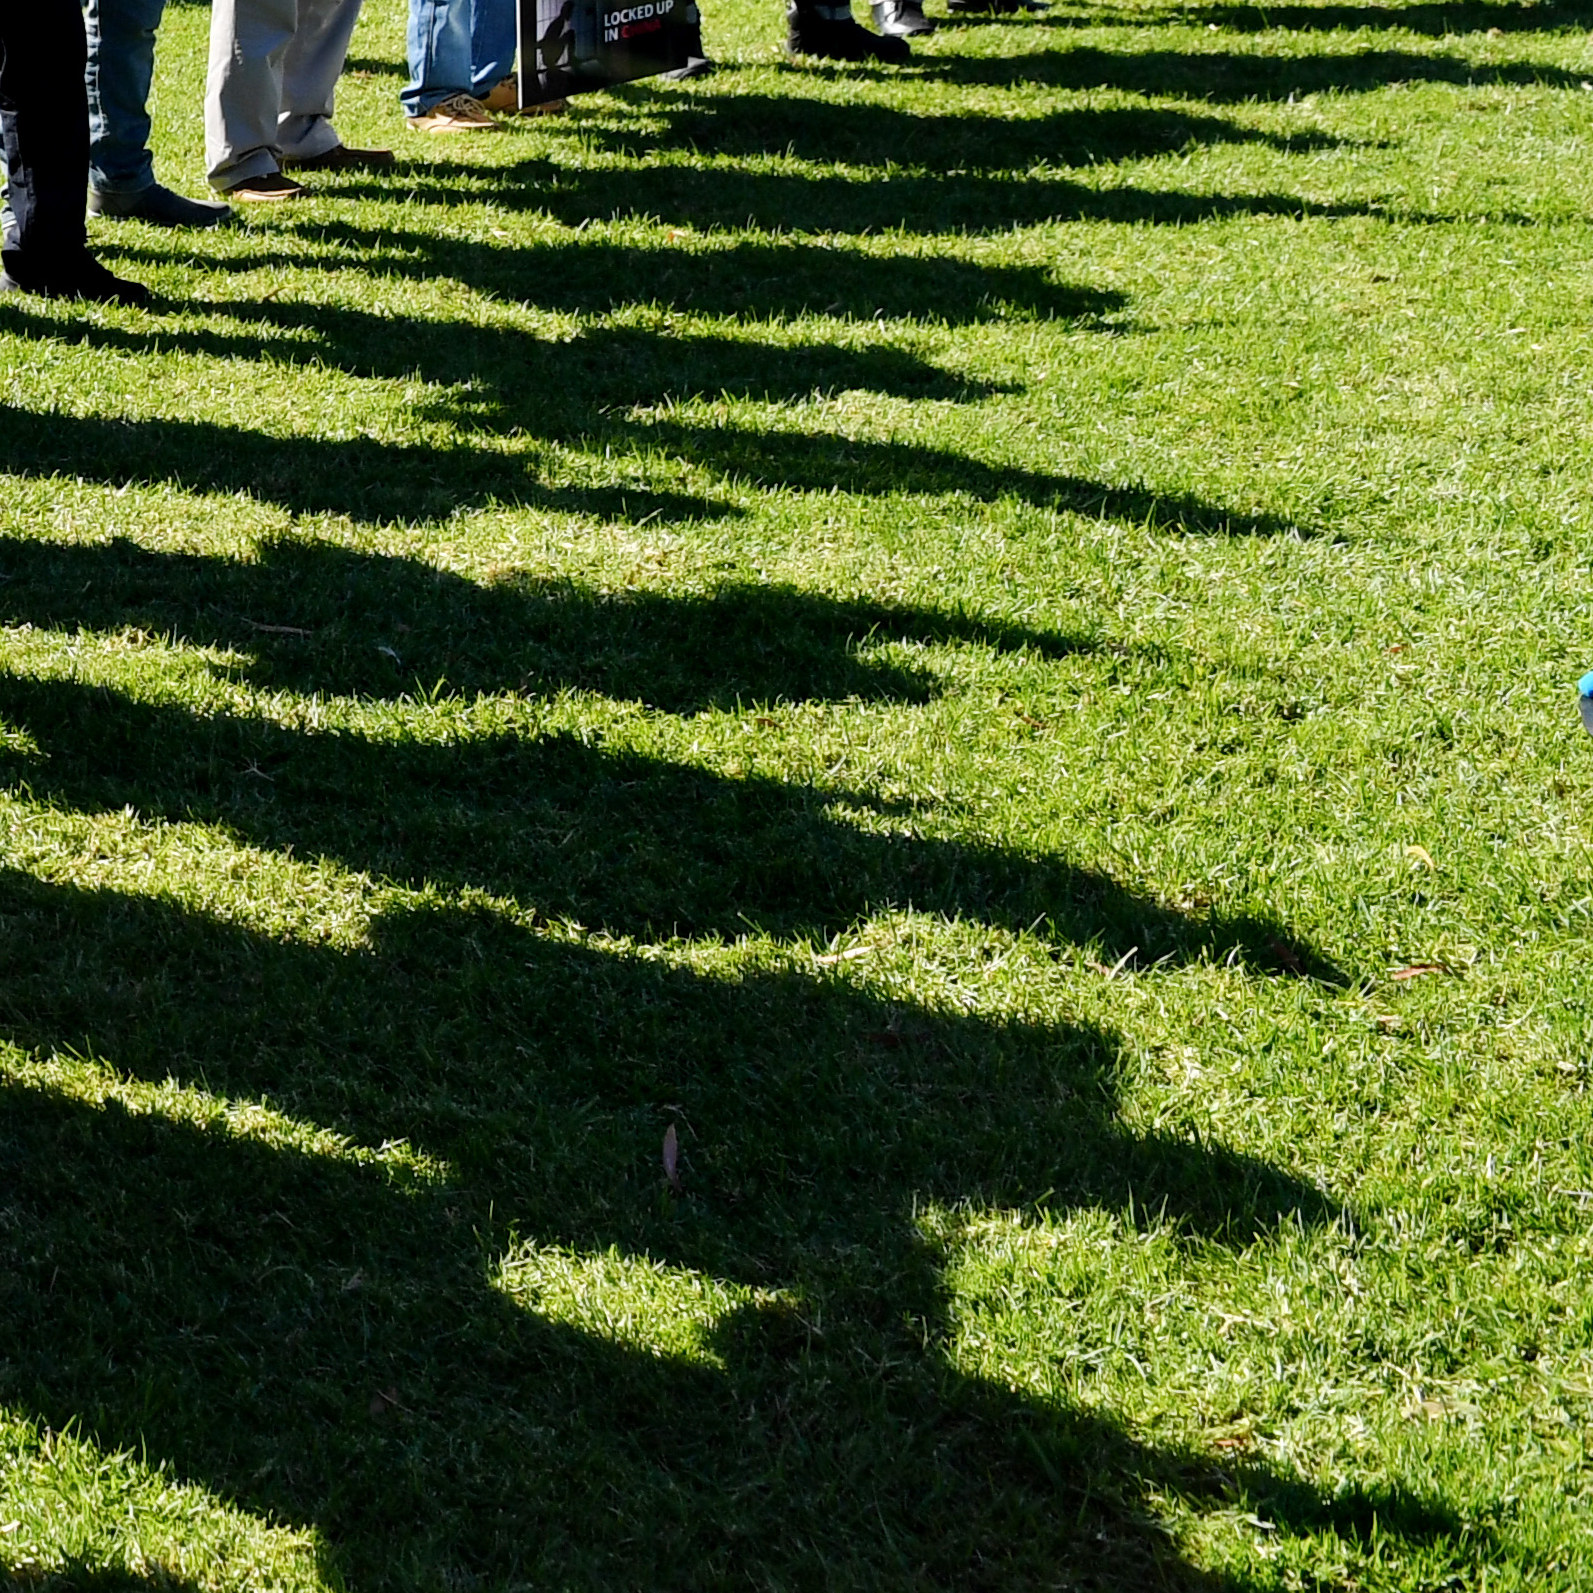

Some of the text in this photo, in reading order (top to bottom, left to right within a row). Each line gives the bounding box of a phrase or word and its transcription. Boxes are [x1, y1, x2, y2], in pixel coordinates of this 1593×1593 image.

[604, 0, 675, 27] LOCKED UP
[604, 26, 620, 43] IN
